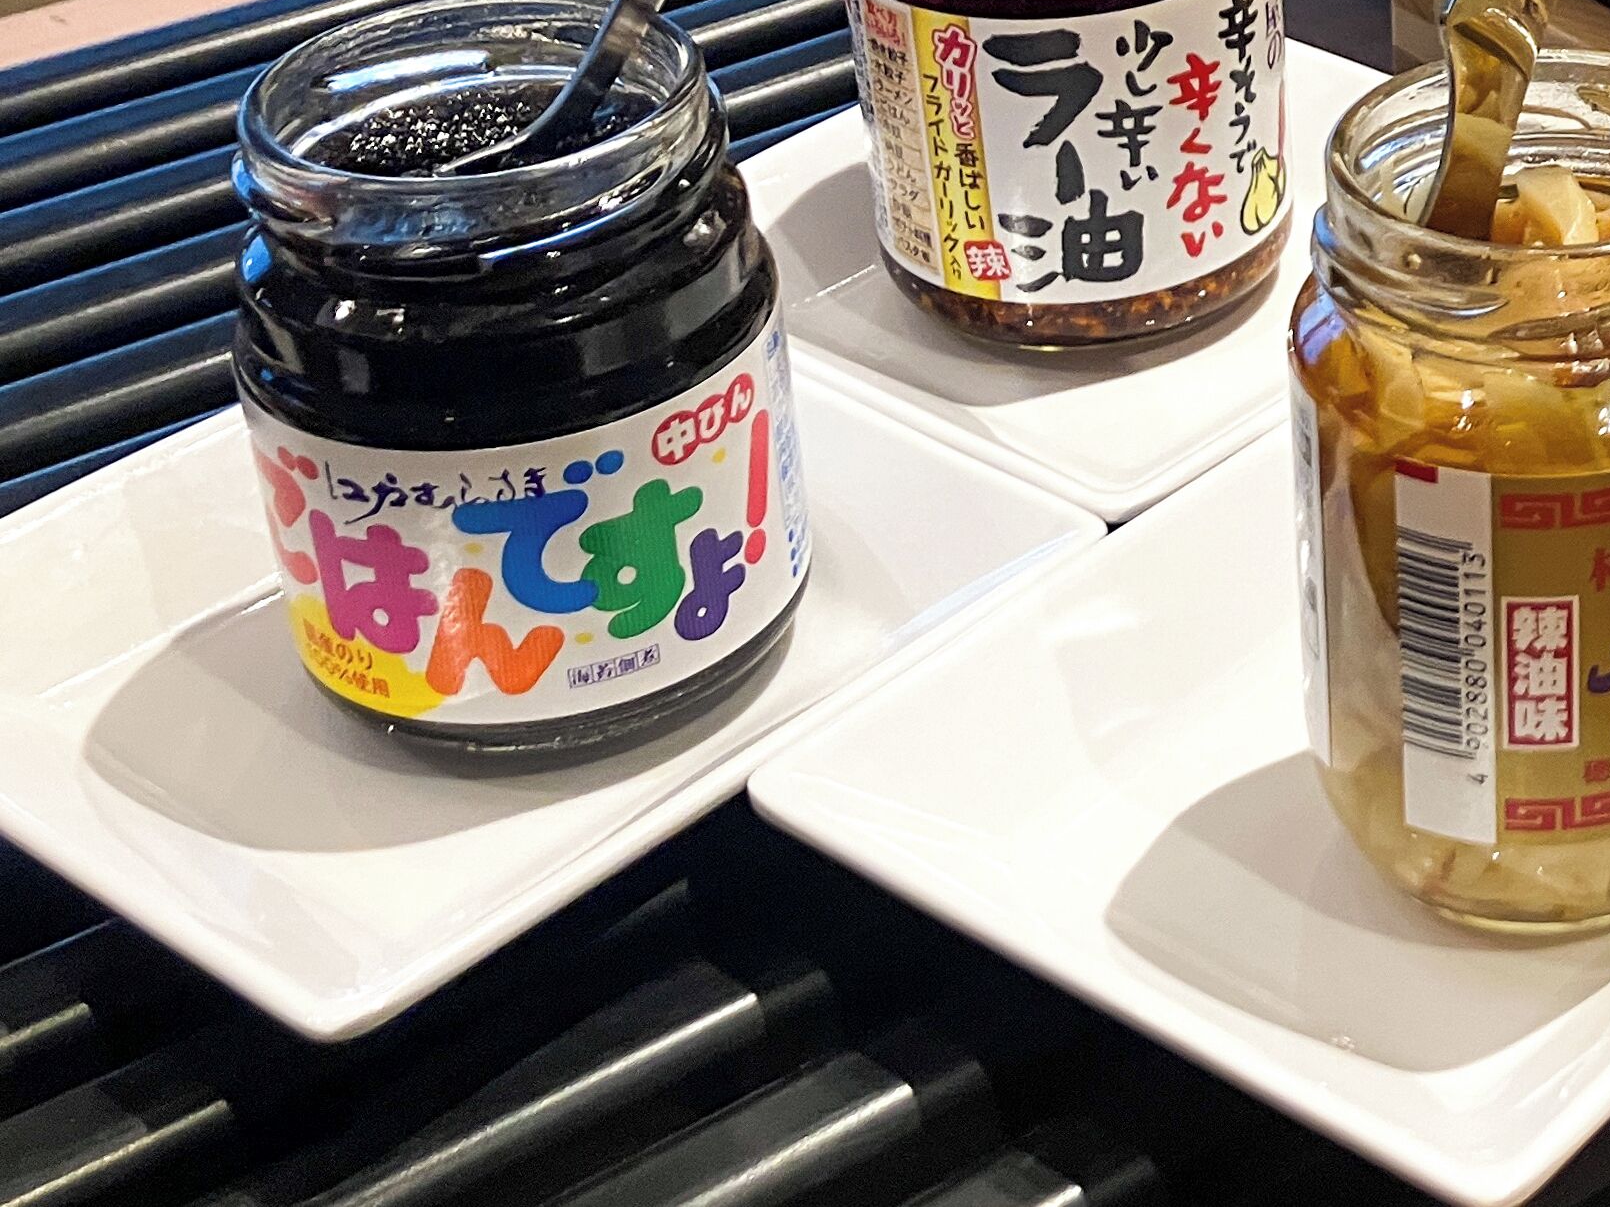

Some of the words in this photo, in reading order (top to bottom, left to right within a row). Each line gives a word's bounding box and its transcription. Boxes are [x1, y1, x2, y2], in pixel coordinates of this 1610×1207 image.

[935, 27, 977, 139] カリッと
[1095, 19, 1175, 191] 少し辛い
[982, 28, 1145, 293] ラー油
[1166, 51, 1228, 259] 辛くない
[967, 242, 1010, 279] 辣
[654, 376, 754, 463] 中びん
[1512, 605, 1570, 744] 辣油味
